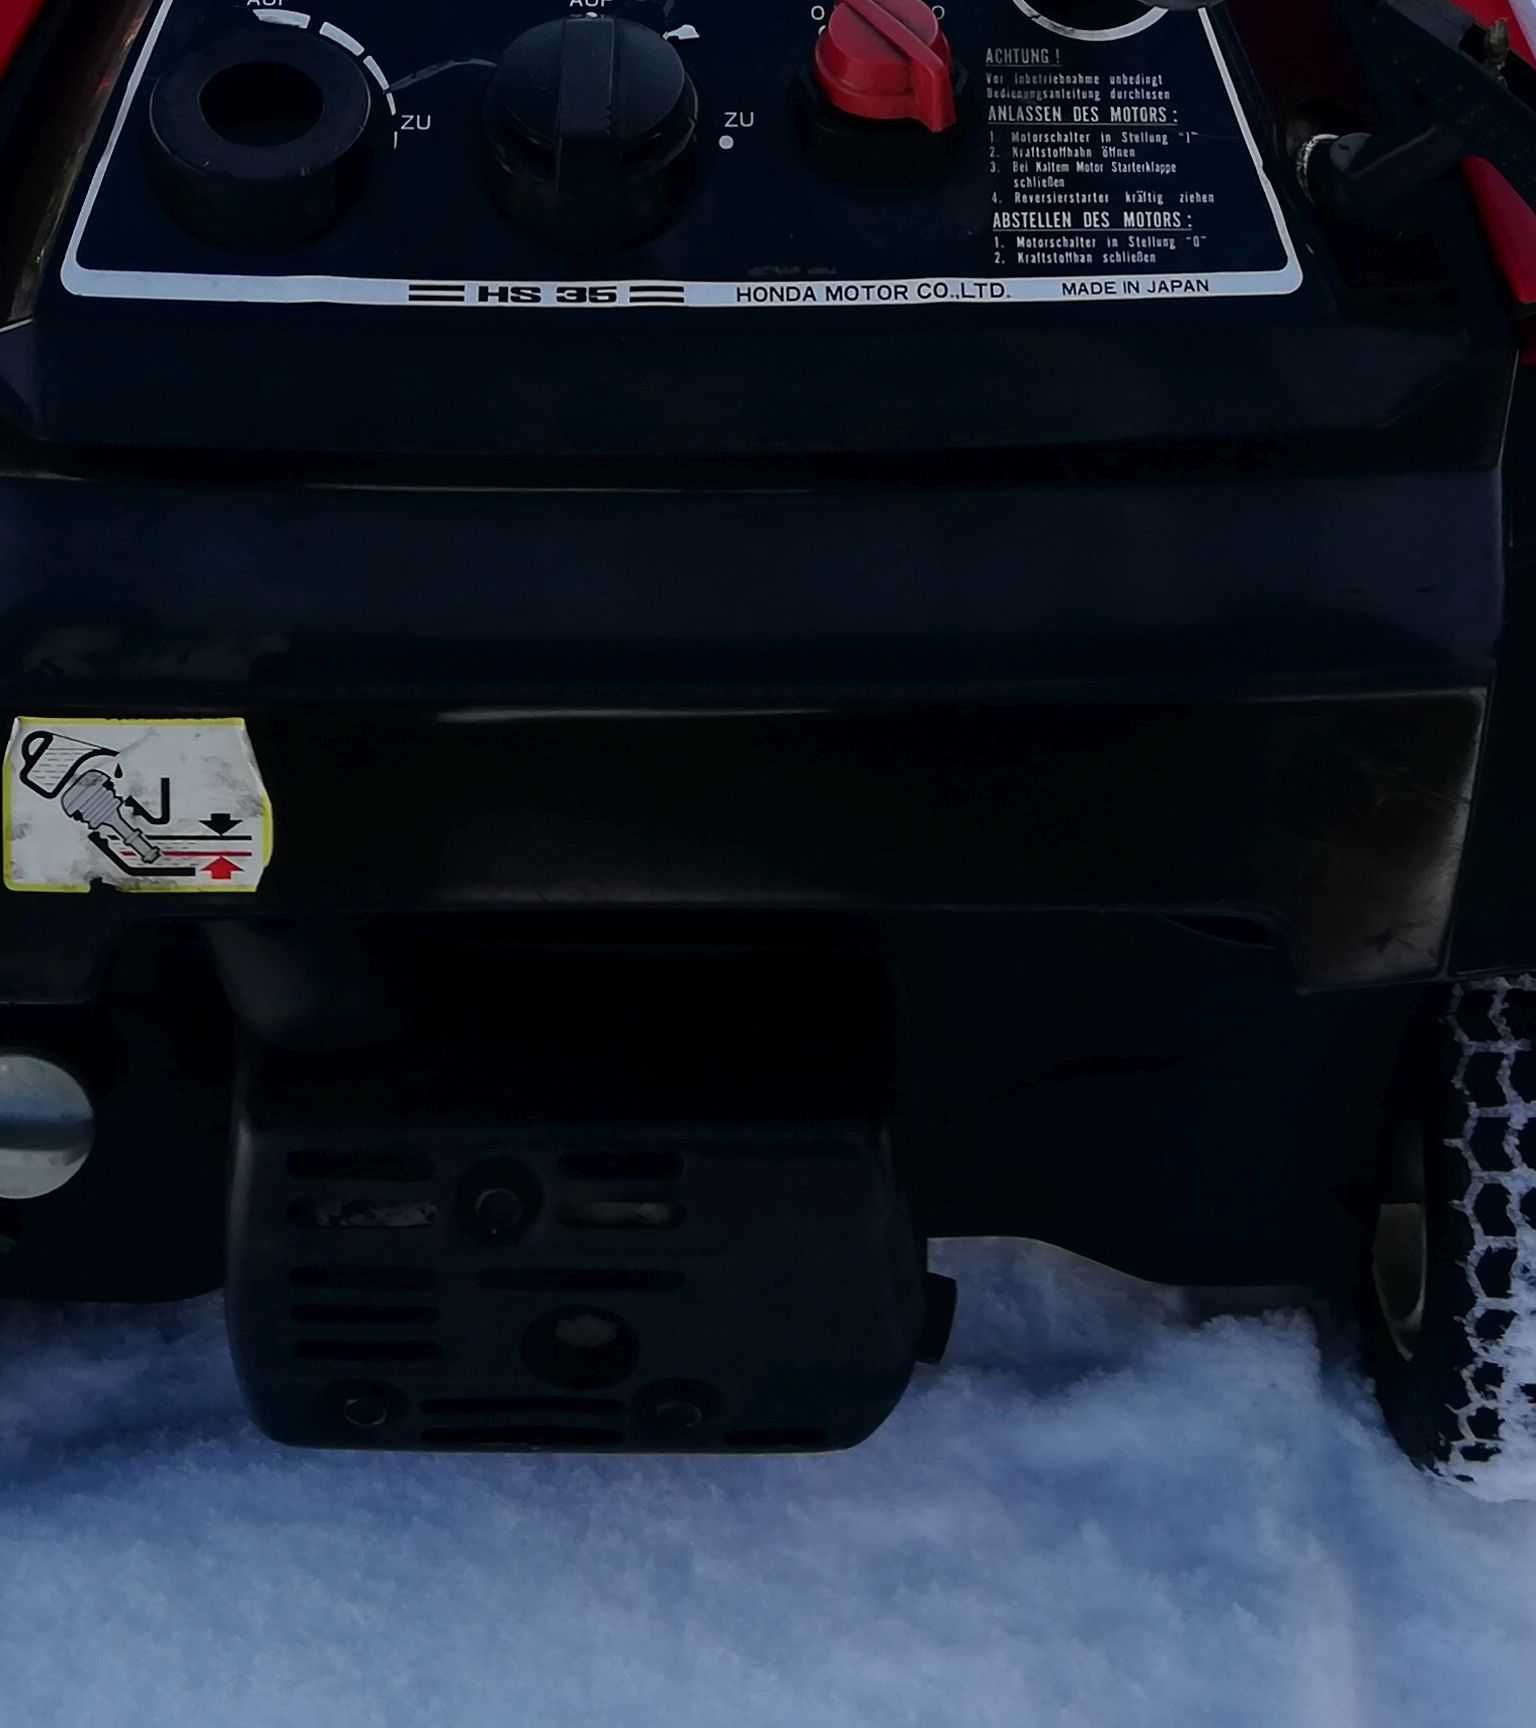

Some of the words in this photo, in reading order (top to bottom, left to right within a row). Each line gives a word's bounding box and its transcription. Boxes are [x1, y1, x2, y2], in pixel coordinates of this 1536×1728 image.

[985, 47, 1050, 64] ACHTUNG
[724, 111, 755, 127] ZU
[988, 105, 1062, 122] ANLASSEN
[1073, 106, 1099, 122] DES
[400, 116, 431, 131] ZU
[1011, 131, 1090, 144] Motorschalter
[1101, 132, 1111, 143] in
[1121, 131, 1168, 145] Stellung
[989, 146, 1000, 158] 2.
[1012, 146, 1092, 159] Kraftstoffhahn
[1102, 145, 1136, 158] öffnen
[990, 160, 1000, 173] 3.
[1012, 161, 1029, 172] Bei
[1076, 161, 1104, 173] Motor
[1111, 161, 1177, 175] Starterklappe
[1013, 176, 1065, 188] schließen
[991, 192, 1003, 204] 4.
[1125, 190, 1164, 205] kräftig
[1179, 192, 1215, 204] ziehen
[993, 211, 1072, 228] ABSTELLEN
[1083, 211, 1110, 228] DES
[994, 236, 1005, 249] 1.
[1016, 236, 1096, 249] Motorschalter
[1107, 236, 1118, 248] in
[1128, 236, 1176, 250] Stellung
[994, 251, 1005, 264] 2.
[1102, 251, 1156, 263] schließen
[477, 286, 541, 304] HS
[555, 286, 617, 304] 35
[736, 286, 816, 303] HONDA
[825, 285, 908, 301] MOTOR
[1061, 282, 1117, 297] MADE
[1122, 282, 1141, 295] IN
[1147, 280, 1209, 294] JAPAN
